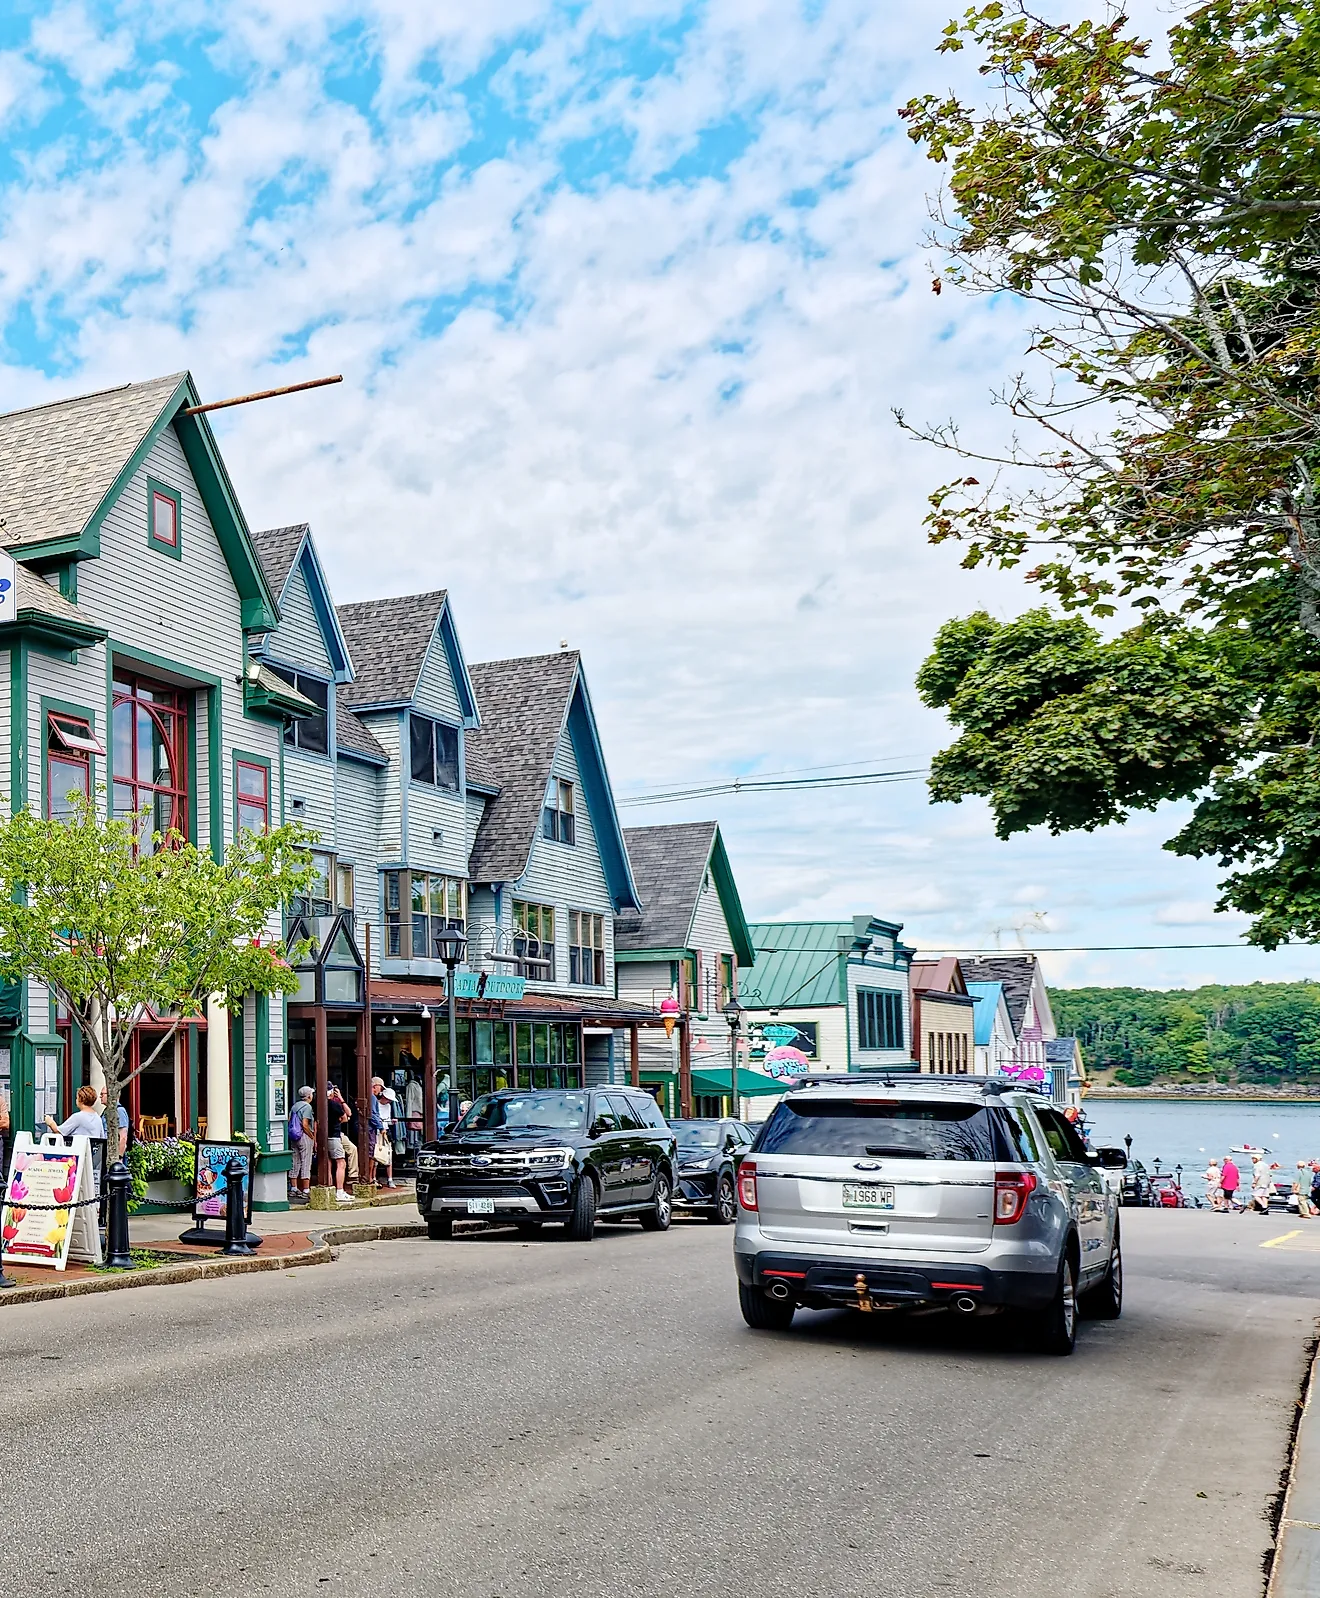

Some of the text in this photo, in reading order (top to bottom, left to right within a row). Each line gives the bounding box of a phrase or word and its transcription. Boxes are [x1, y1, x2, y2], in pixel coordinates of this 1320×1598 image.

[485, 980, 524, 994] OUTDOORS
[853, 1190, 892, 1203] 1968 WP
